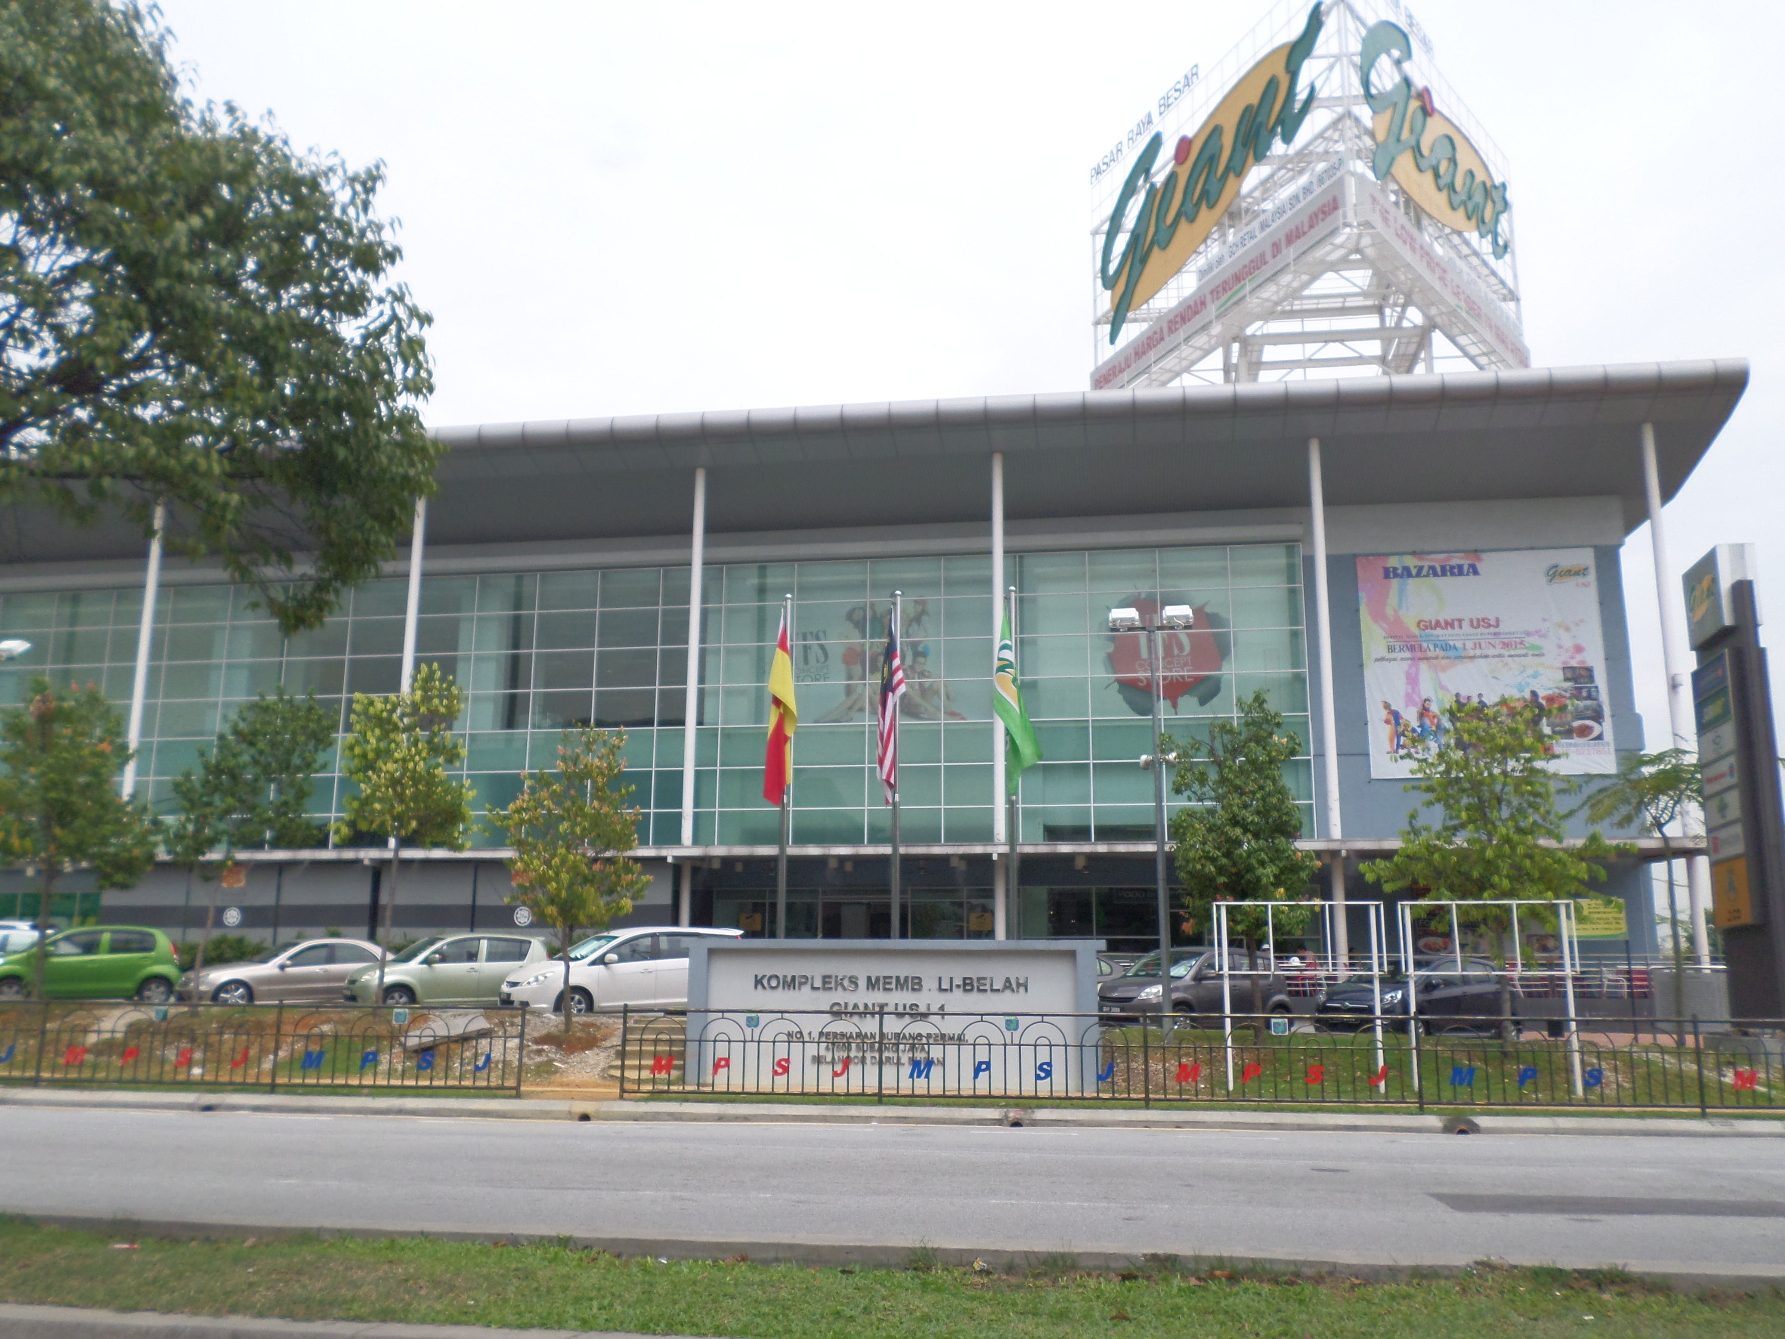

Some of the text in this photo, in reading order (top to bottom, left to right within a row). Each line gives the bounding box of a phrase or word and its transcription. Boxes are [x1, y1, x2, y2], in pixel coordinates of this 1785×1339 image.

[1090, 62, 1199, 185] PASAR RAYA BESAR
[1360, 20, 1508, 260] Giant
[1101, 2, 1324, 346] Giant
[1134, 326, 1166, 363] HARGA
[1167, 297, 1207, 338] RENDAH
[1209, 251, 1270, 305] TERUNGGUL
[1271, 238, 1283, 259] DI
[1285, 194, 1339, 249] MALAYSIA
[1382, 563, 1482, 580] BAZARIA
[1547, 563, 1590, 584] Giant
[1416, 617, 1500, 631] GIANT USJ
[1387, 643, 1432, 654] BERMULA
[1433, 642, 1458, 652] PADA
[1470, 641, 1498, 651] JUN
[1500, 640, 1526, 650] 2015
[754, 974, 859, 992] KOMPLEKS
[830, 1002, 946, 1019] GIANT USJ 1
[819, 1031, 876, 1042] PERSIARAN
[64, 1046, 249, 1068] M P S J
[301, 1050, 492, 1072] M P S J
[650, 1056, 851, 1077] M P S J
[909, 1059, 1114, 1081] M P S J
[1175, 1063, 1389, 1086] M P S J
[1450, 1066, 1603, 1088] M P S
[1733, 1069, 1758, 1089] M
